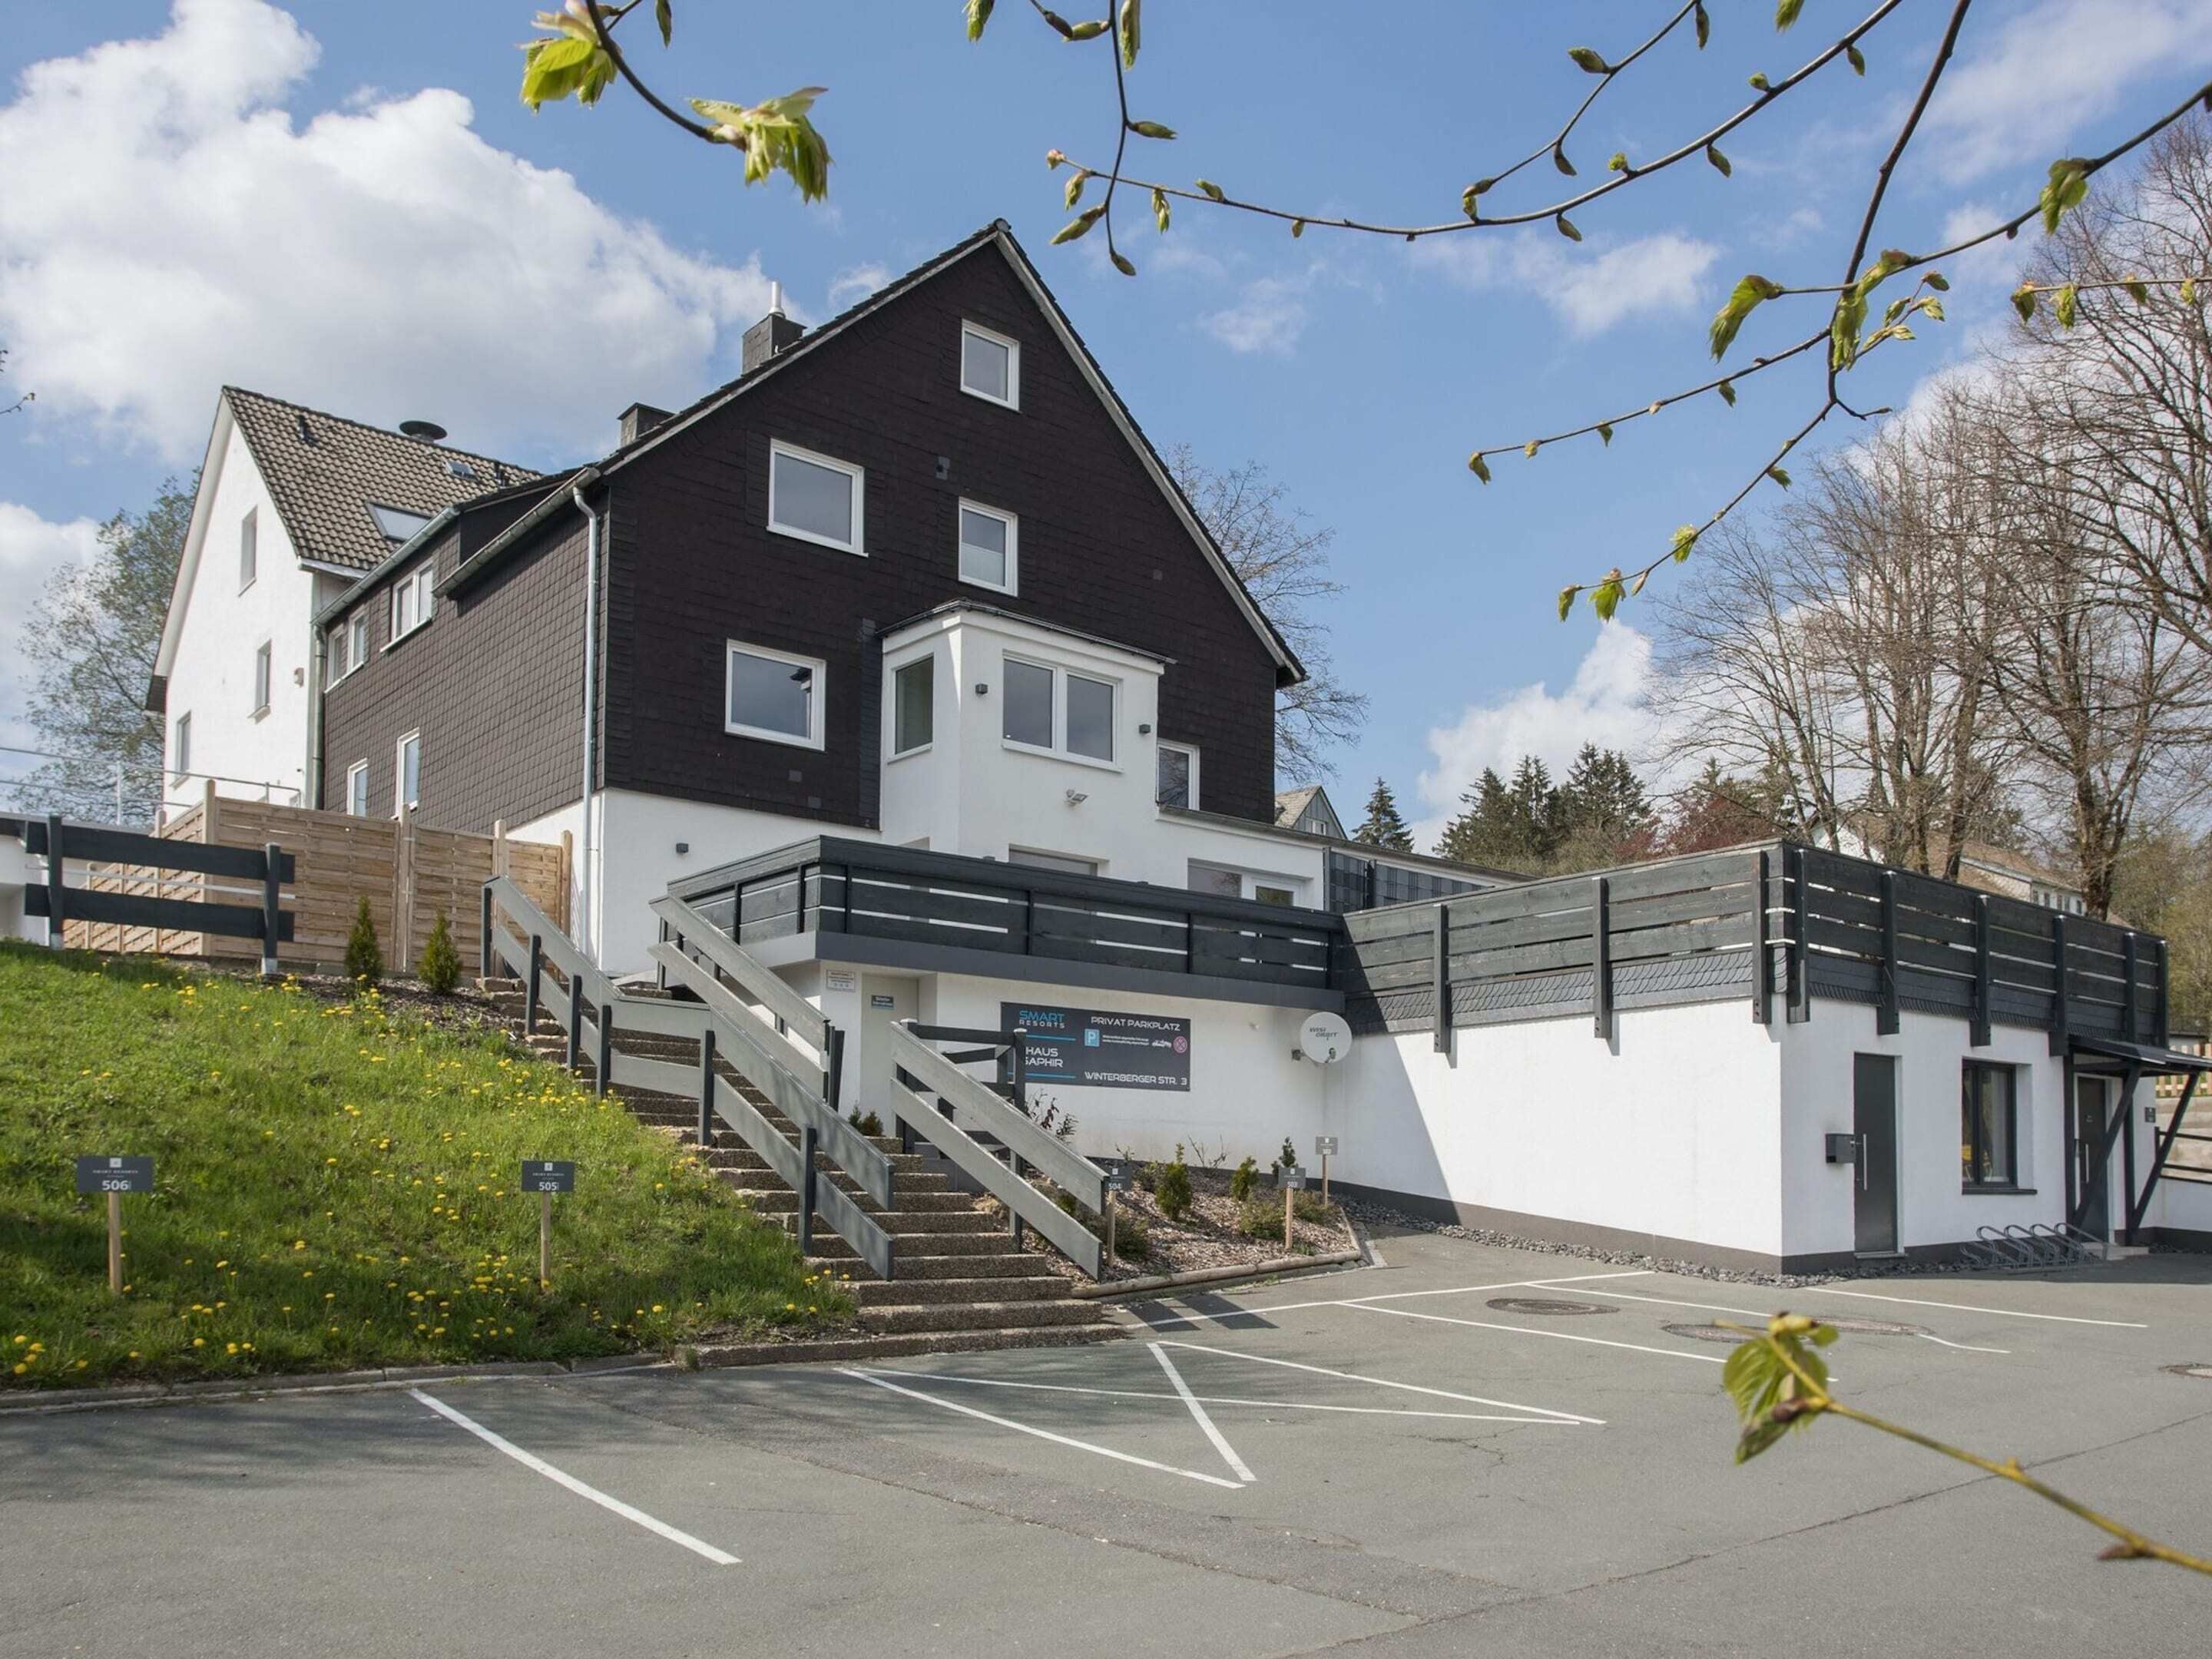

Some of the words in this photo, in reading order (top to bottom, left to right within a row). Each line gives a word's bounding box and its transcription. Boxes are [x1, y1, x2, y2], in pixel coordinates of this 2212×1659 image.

[1018, 1010, 1065, 1022] SMART
[1018, 1019, 1065, 1029] RESORTS
[1091, 1016, 1126, 1028] PRIVAT
[1127, 1019, 1181, 1031] PARKPLATZ
[1025, 1047, 1058, 1058] HAUS
[1084, 1071, 1157, 1084] WINTERBERGER
[1157, 1076, 1177, 1085] STR.
[1180, 1077, 1187, 1085] 3
[101, 1180, 130, 1191] 506
[538, 1181, 558, 1191] 505
